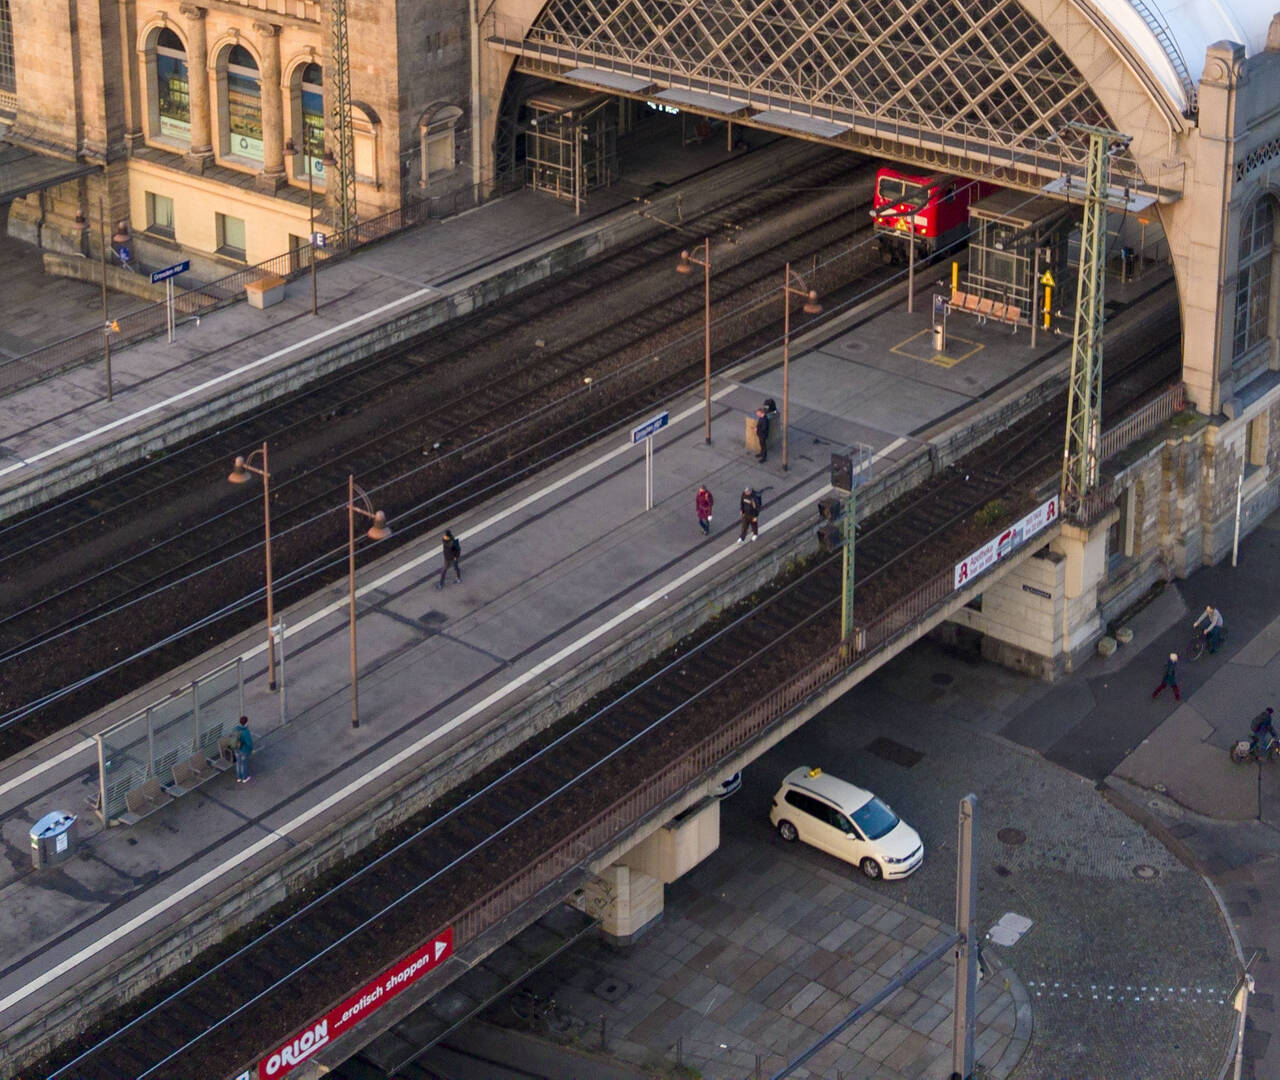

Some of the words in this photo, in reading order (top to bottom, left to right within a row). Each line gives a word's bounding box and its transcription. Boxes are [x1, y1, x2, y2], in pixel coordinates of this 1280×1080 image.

[316, 232, 324, 246] E
[153, 268, 174, 281] Dresden
[333, 985, 384, 1029] ...erotisch
[385, 953, 430, 992] shoppen
[265, 1019, 329, 1075] ORION
